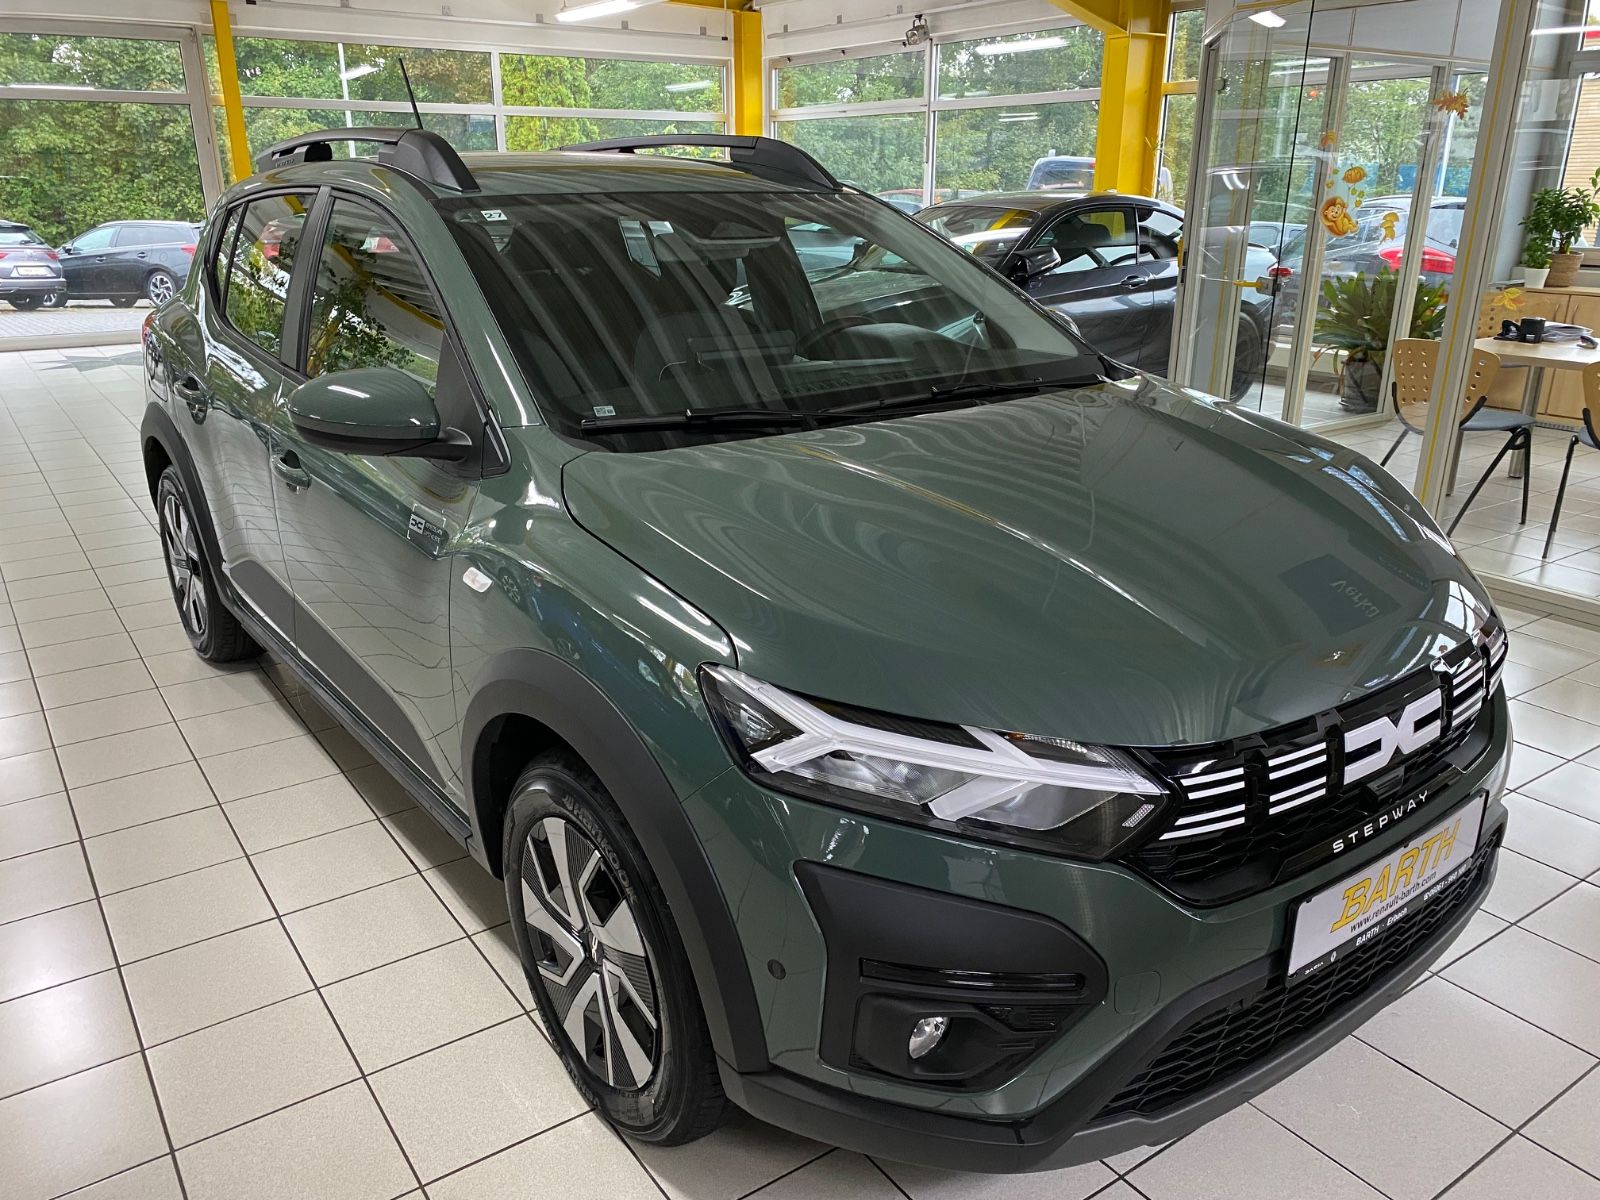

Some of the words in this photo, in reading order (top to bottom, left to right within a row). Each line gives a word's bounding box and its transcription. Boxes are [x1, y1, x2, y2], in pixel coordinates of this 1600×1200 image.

[1332, 790, 1429, 854] STEPWAY
[1330, 818, 1462, 934] BARTH
[1355, 925, 1380, 946] BARTH
